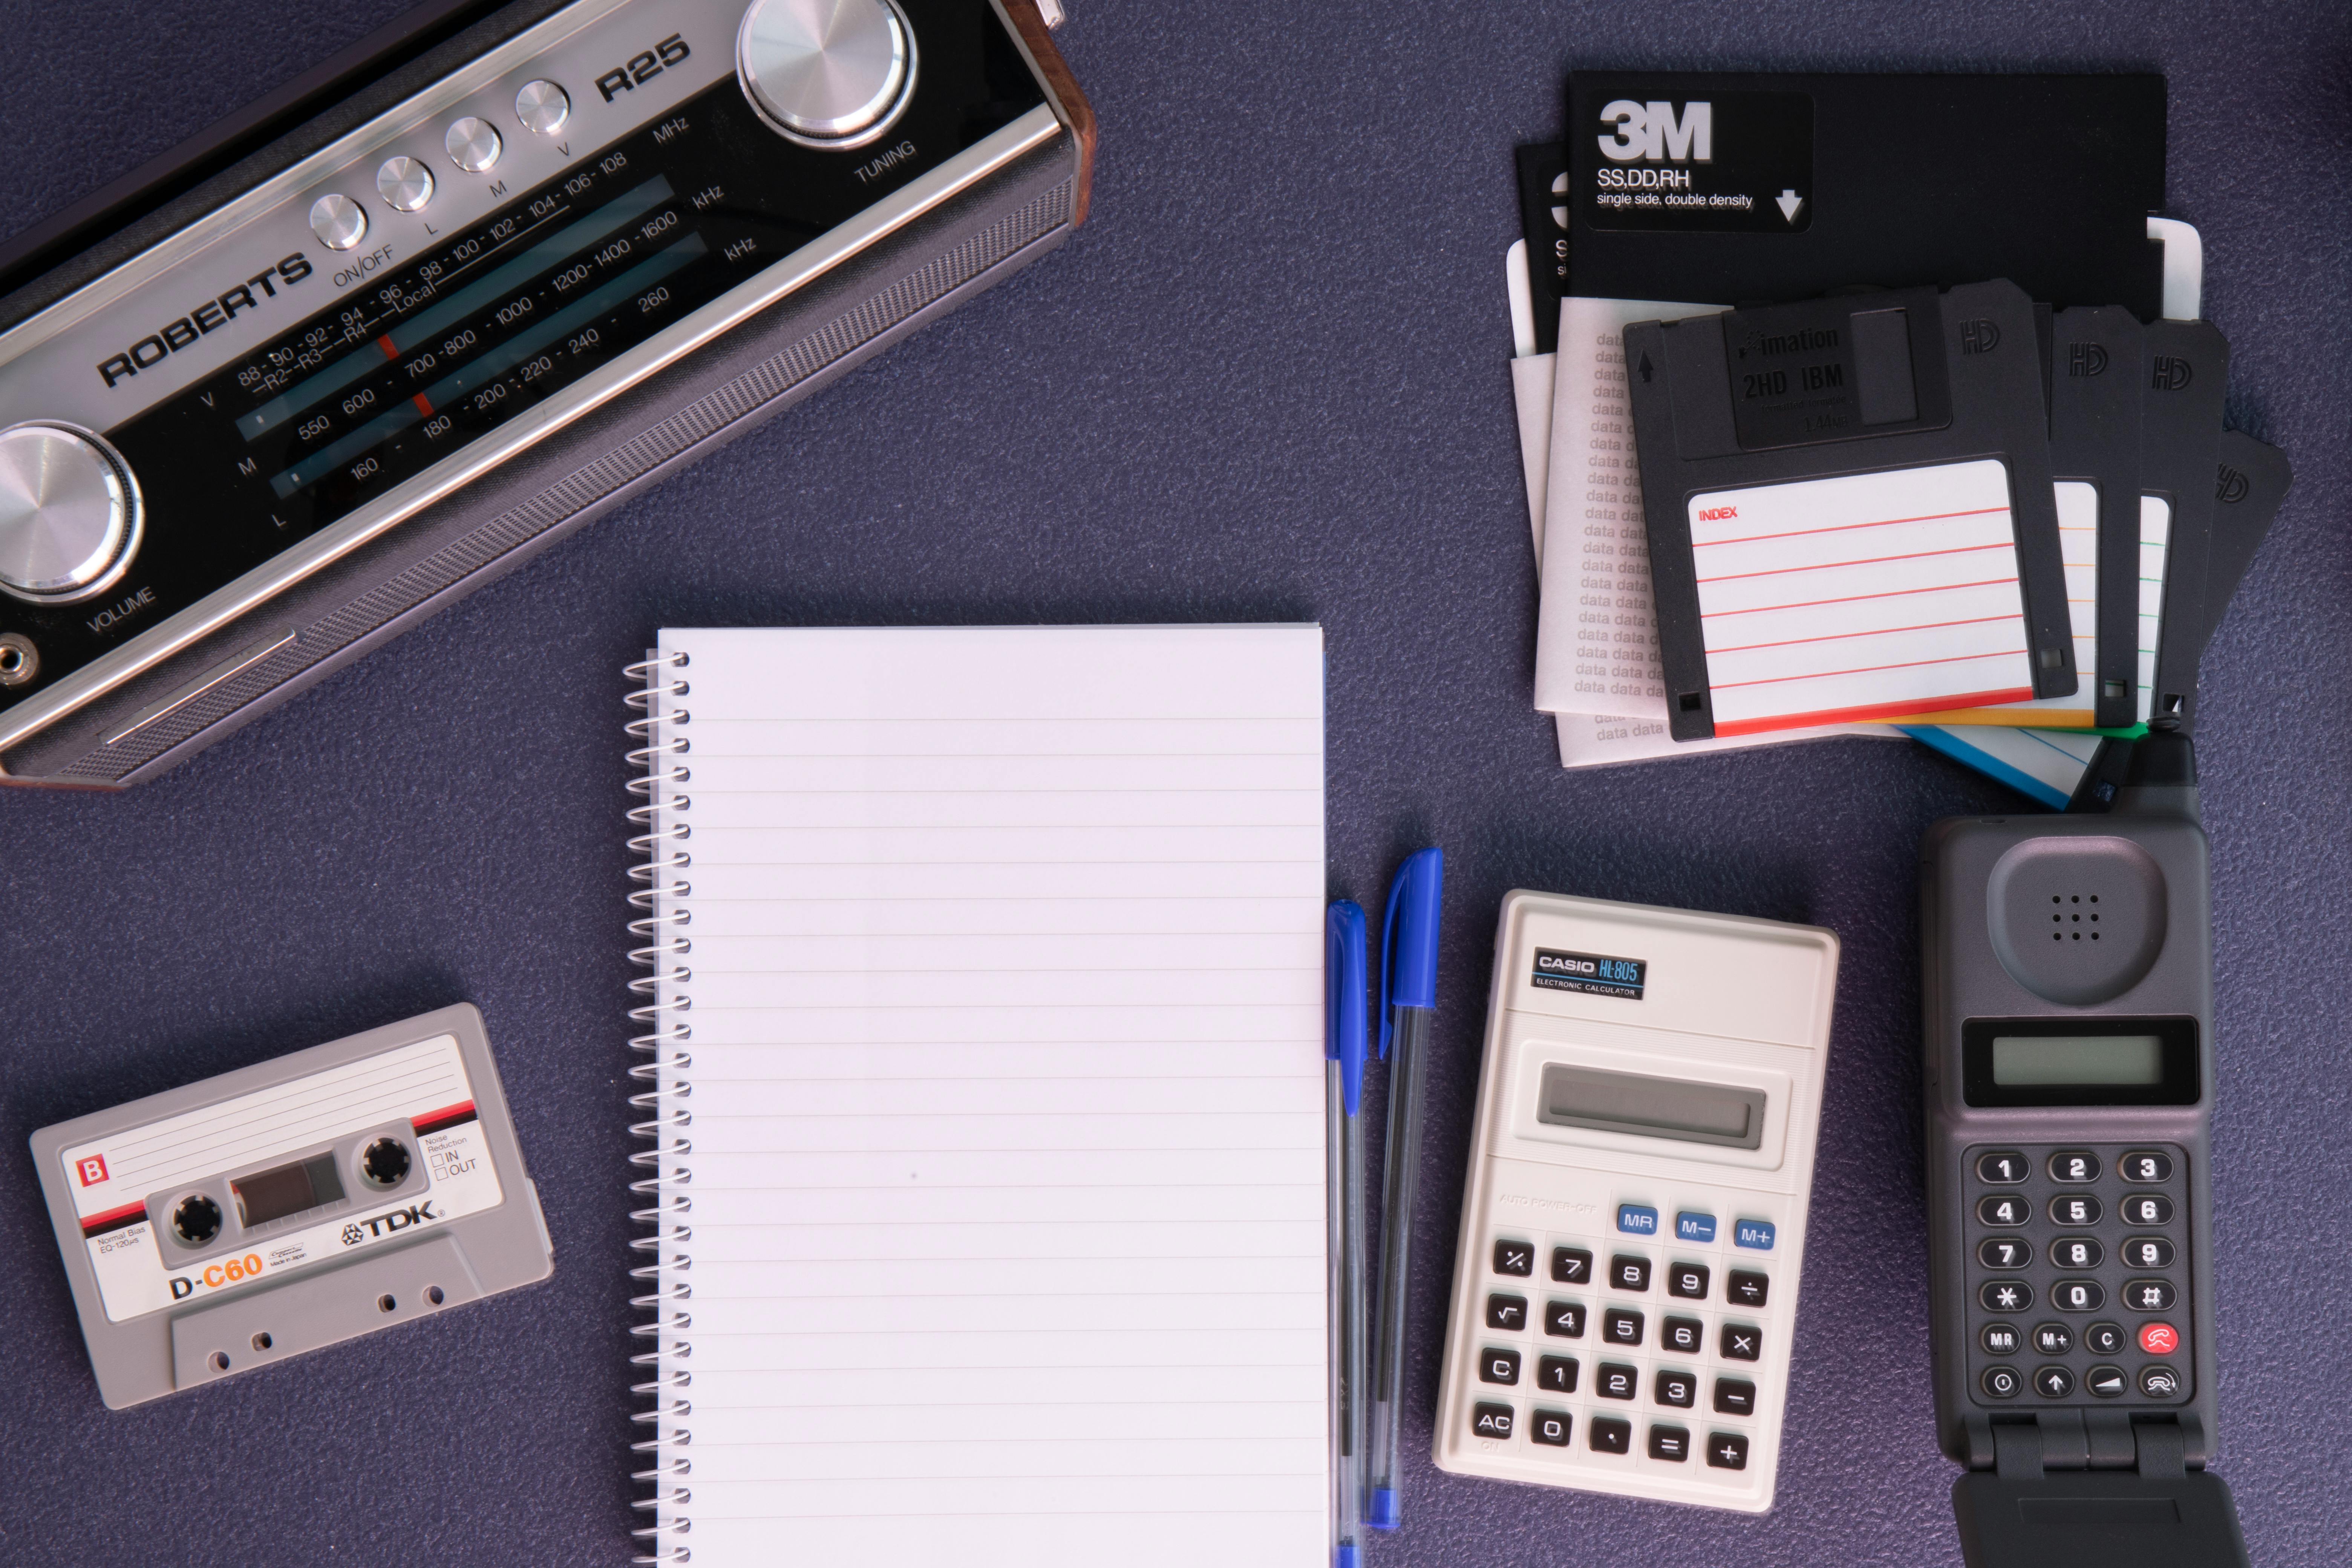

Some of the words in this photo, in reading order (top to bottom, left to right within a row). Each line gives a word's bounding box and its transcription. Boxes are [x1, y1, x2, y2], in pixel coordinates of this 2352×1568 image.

[594, 33, 691, 103] R25
[652, 117, 689, 144] MHz
[1598, 100, 1711, 160] 3M
[557, 142, 570, 156] V
[854, 141, 916, 184] TUNING
[1598, 170, 1689, 189] SS,DD,RH
[490, 180, 507, 197] M
[692, 185, 724, 210] kHz
[1597, 193, 1631, 207] single
[1635, 193, 1661, 205] side,
[1665, 194, 1706, 205] double
[1710, 195, 1752, 208] density
[425, 223, 438, 234] L
[724, 236, 756, 260] kHz
[238, 367, 260, 386] 88
[272, 348, 294, 366] 90
[306, 328, 328, 346] 92
[341, 307, 363, 326] 94
[380, 285, 402, 303] 96
[420, 262, 442, 280] 98
[453, 239, 479, 260] 100
[489, 219, 516, 240] 102
[529, 198, 556, 217] 104
[564, 173, 591, 194] 106
[600, 152, 626, 174] 108
[334, 244, 394, 287] ON/OFF
[96, 252, 312, 388] ROBERTS
[299, 416, 330, 440] 550
[343, 389, 375, 414] 600
[405, 354, 435, 378] 700
[444, 330, 476, 355] 800
[495, 297, 532, 325] 1000
[552, 265, 588, 291] 1200
[594, 239, 631, 267] 1400
[640, 211, 677, 240] 1600
[1760, 328, 1838, 355] imation
[1594, 368, 1625, 381] data
[1743, 370, 1787, 399] 2HD
[1802, 363, 1843, 390] IBM
[351, 458, 378, 480] 160
[423, 416, 451, 439] 180
[474, 384, 505, 409] 200
[521, 357, 552, 382] 220
[569, 329, 600, 354] 240
[639, 287, 669, 312] 260
[201, 392, 214, 407] V
[1593, 386, 1623, 398] data
[1592, 403, 1623, 416] data
[1591, 421, 1621, 433] data
[1590, 438, 1620, 451] data
[238, 458, 257, 475] M
[1588, 455, 1619, 468] data
[1587, 472, 1618, 485] data
[1586, 490, 1617, 502] data
[272, 515, 286, 527] L
[1585, 507, 1616, 520] data
[1699, 507, 1737, 521] INDEX
[1584, 525, 1615, 537] data
[1583, 542, 1614, 554] data
[1582, 559, 1612, 571] data
[1618, 561, 1649, 574] data
[1580, 576, 1611, 589] data
[1617, 579, 1648, 592] data
[1580, 594, 1611, 606] data
[1615, 596, 1646, 609] data
[87, 587, 156, 632] VOLUME
[1579, 611, 1609, 623] data
[1614, 614, 1646, 626] data
[1577, 628, 1608, 641] data
[1614, 631, 1644, 644] data
[1577, 646, 1607, 658] data
[1612, 648, 1643, 661] data
[1576, 663, 1606, 675] data
[1611, 665, 1642, 678] data
[1574, 680, 1605, 693] data
[1610, 683, 1641, 695] data
[1597, 728, 1628, 741] data
[1632, 723, 1663, 736] data
[1539, 956, 1594, 972] CASIO
[1599, 959, 1638, 981] HL-805
[1537, 978, 1582, 989] ELECTRONIC
[1585, 985, 1635, 995] CALCULATOR
[425, 1135, 447, 1146] Noise
[427, 1137, 467, 1153] Reduction
[445, 1150, 459, 1162] IN
[83, 1160, 103, 1182] B
[450, 1159, 476, 1175] OUT
[1998, 1161, 2009, 1177] 1
[2070, 1159, 2084, 1176] 2
[2141, 1159, 2155, 1176] 3
[1500, 1194, 1528, 1206] AUTO
[1532, 1199, 1597, 1214] POWER-OFF
[1997, 1203, 2012, 1219] 4
[2070, 1202, 2085, 1219] 5
[2141, 1201, 2156, 1218] 6
[360, 1200, 438, 1237] TDK
[1624, 1215, 1652, 1229] MR
[98, 1232, 126, 1245] Normal
[127, 1227, 145, 1237] Bias
[1741, 1228, 1770, 1243] M+
[1999, 1245, 2013, 1262] 7
[2072, 1245, 2086, 1262] 8
[2142, 1244, 2157, 1262] 9
[1565, 1259, 1581, 1273] 7
[1623, 1266, 1639, 1281] 8
[169, 1254, 263, 1300] D-C60
[1682, 1274, 1698, 1289] 9
[2071, 1287, 2086, 1305] 0
[1558, 1312, 1574, 1327] 4
[1617, 1321, 1633, 1336] 5
[1675, 1328, 1691, 1343] 6
[1991, 1333, 2012, 1345] MR
[2043, 1333, 2066, 1345] M+
[2102, 1333, 2112, 1345] C
[1493, 1361, 1510, 1375] C
[1554, 1368, 1563, 1382] 1
[1609, 1375, 1626, 1390] 2
[1669, 1383, 1685, 1398] 3
[1479, 1415, 1510, 1430] AC
[1544, 1421, 1560, 1436] 0
